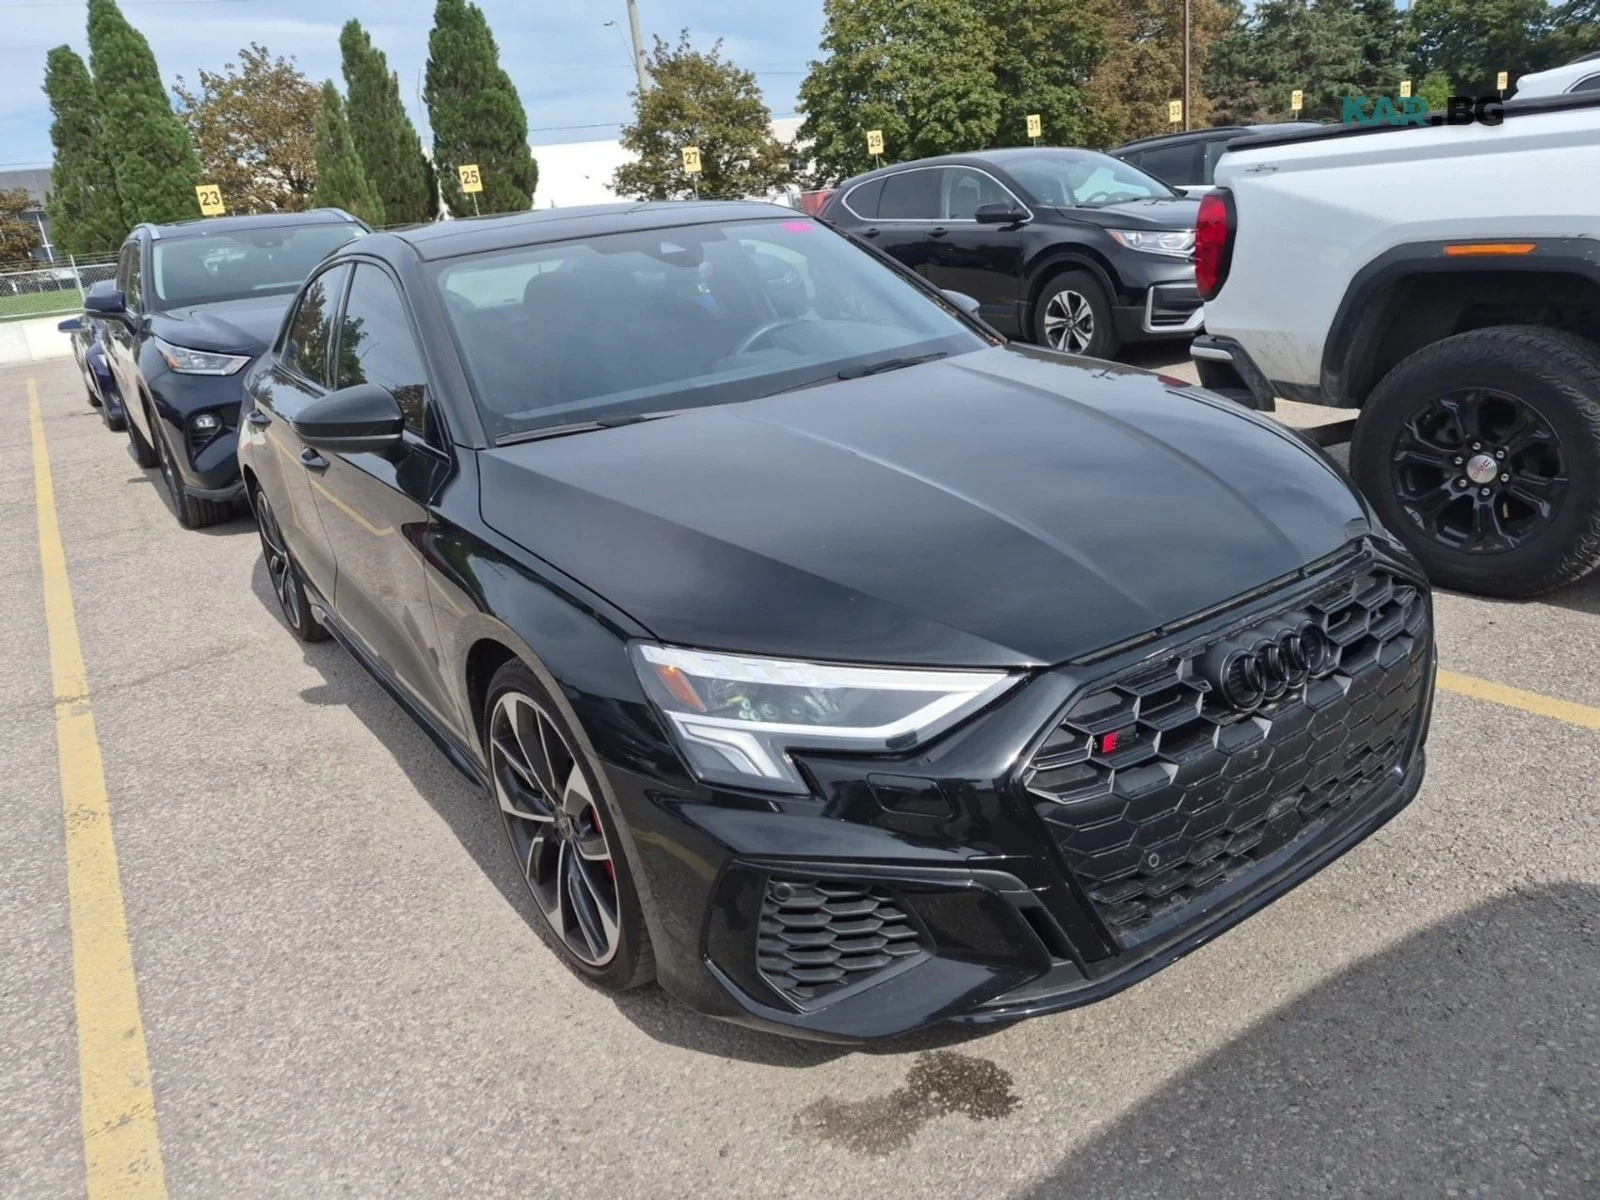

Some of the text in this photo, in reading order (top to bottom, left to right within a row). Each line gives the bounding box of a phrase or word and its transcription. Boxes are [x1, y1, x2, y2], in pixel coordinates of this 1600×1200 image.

[1171, 104, 1181, 116] 33
[1028, 118, 1039, 130] 31
[869, 135, 881, 148] 29
[684, 151, 698, 165] 27
[461, 170, 479, 185] 25
[199, 190, 220, 206] 23
[1472, 459, 1491, 479] GMC
